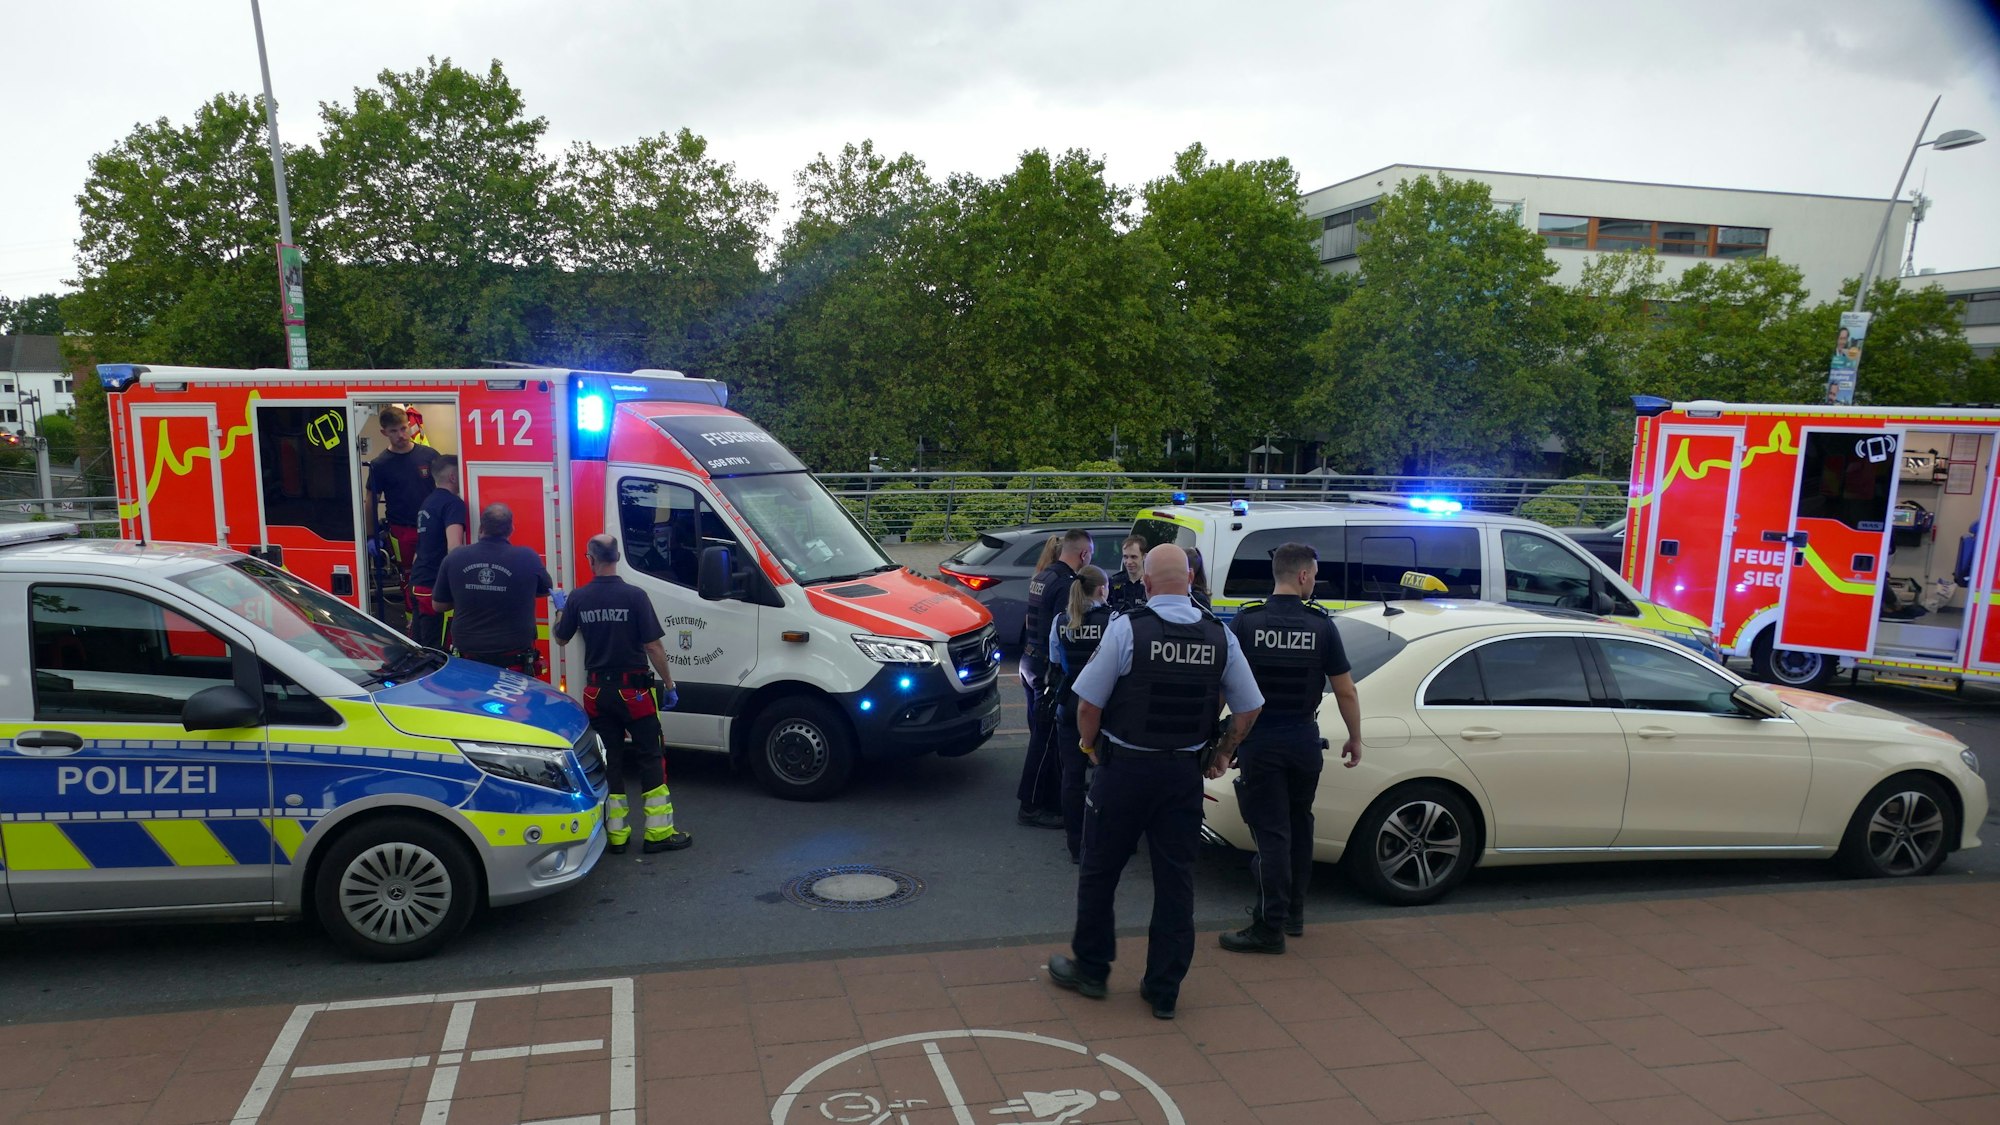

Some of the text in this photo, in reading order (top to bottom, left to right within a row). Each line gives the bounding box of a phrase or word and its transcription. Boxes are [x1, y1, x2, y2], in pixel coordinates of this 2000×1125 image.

[468, 409, 533, 445] 112
[708, 458, 728, 468] SGB
[1734, 549, 1784, 566] FEUE
[1405, 574, 1425, 587] TAXI
[580, 609, 630, 623] NOTARZT
[664, 615, 708, 629] Feuerwehr
[1254, 630, 1316, 650] POLIZEI
[693, 647, 724, 666] Siegburg
[1150, 641, 1216, 665] POLIZEI
[58, 766, 217, 795] POLIZEI
